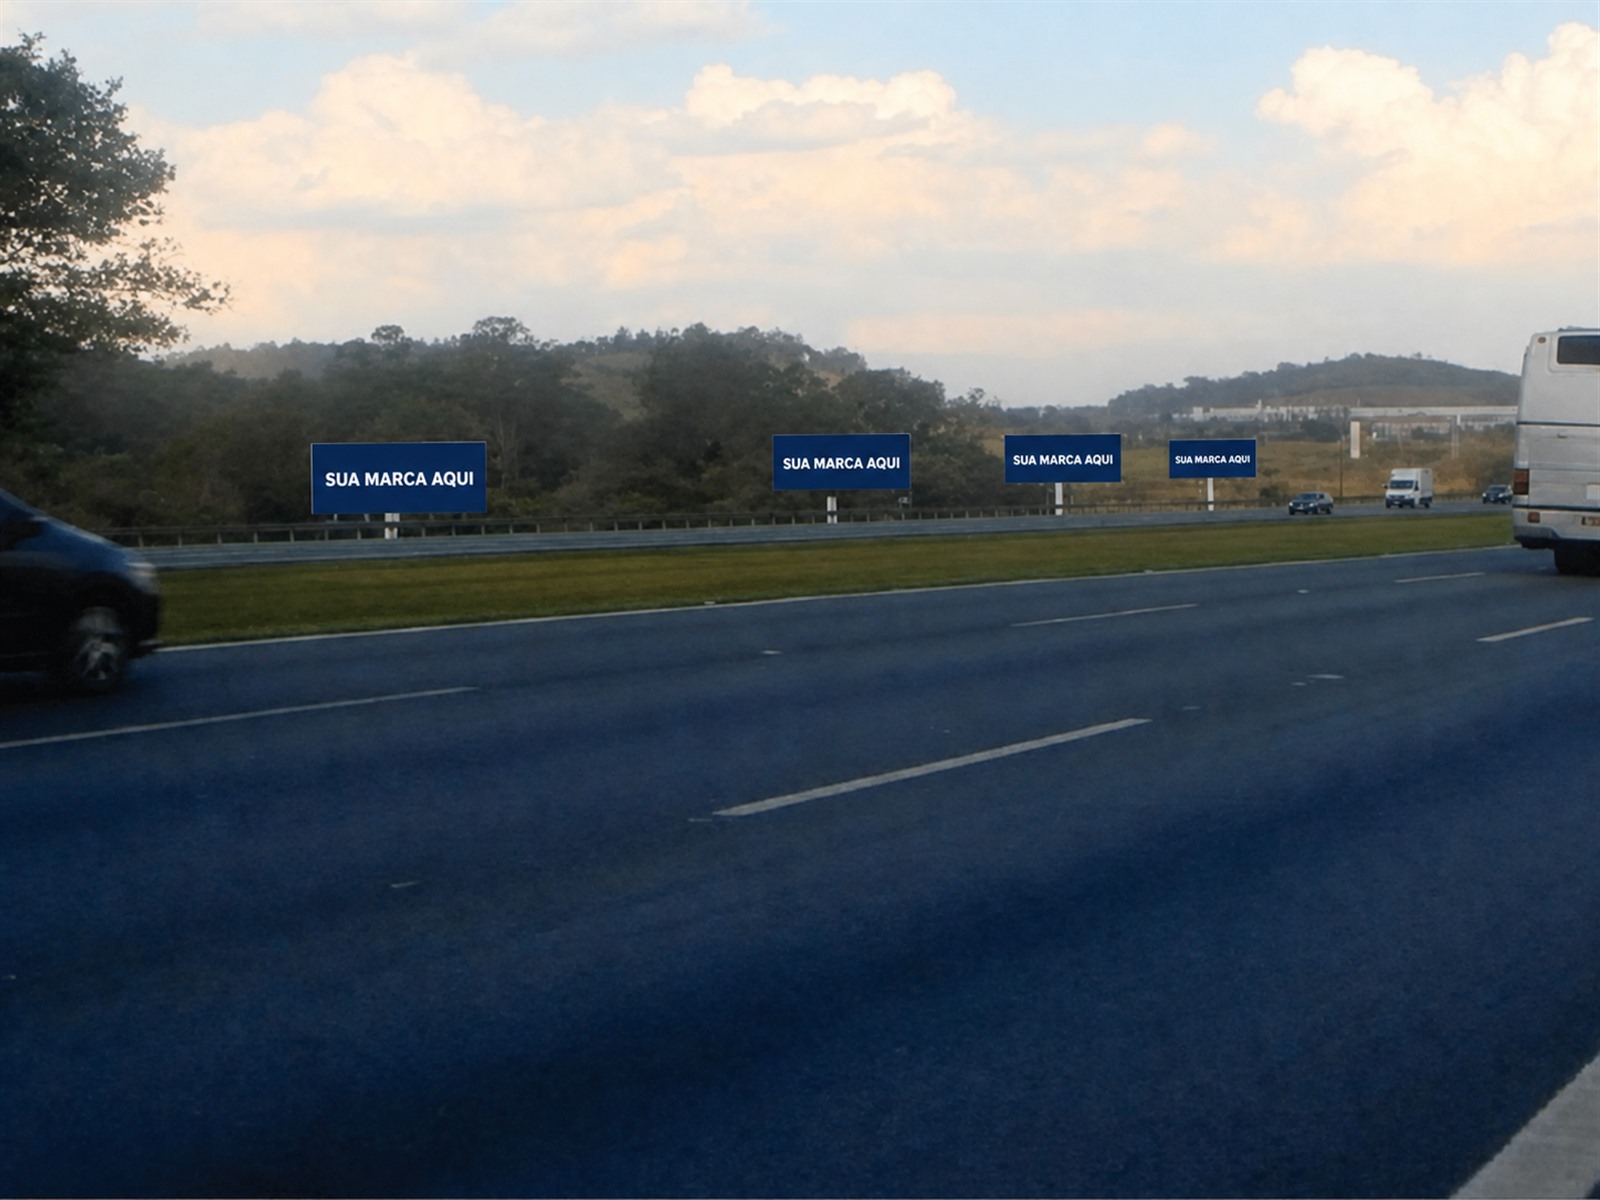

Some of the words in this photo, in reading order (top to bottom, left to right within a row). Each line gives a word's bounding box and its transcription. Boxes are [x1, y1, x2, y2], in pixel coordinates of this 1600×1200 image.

[783, 457, 810, 469] SUA
[814, 457, 863, 469] MARCA
[867, 457, 900, 470] AQUI
[1013, 455, 1037, 465] SUA
[1040, 455, 1082, 465] MARCA
[1085, 454, 1113, 465] AQUI
[1175, 455, 1193, 464] SUA
[1194, 455, 1227, 464] MARCA
[1228, 455, 1250, 464] AQUI
[325, 472, 360, 486] SUA
[365, 472, 428, 486] MARCA
[432, 471, 473, 487] AQUI
